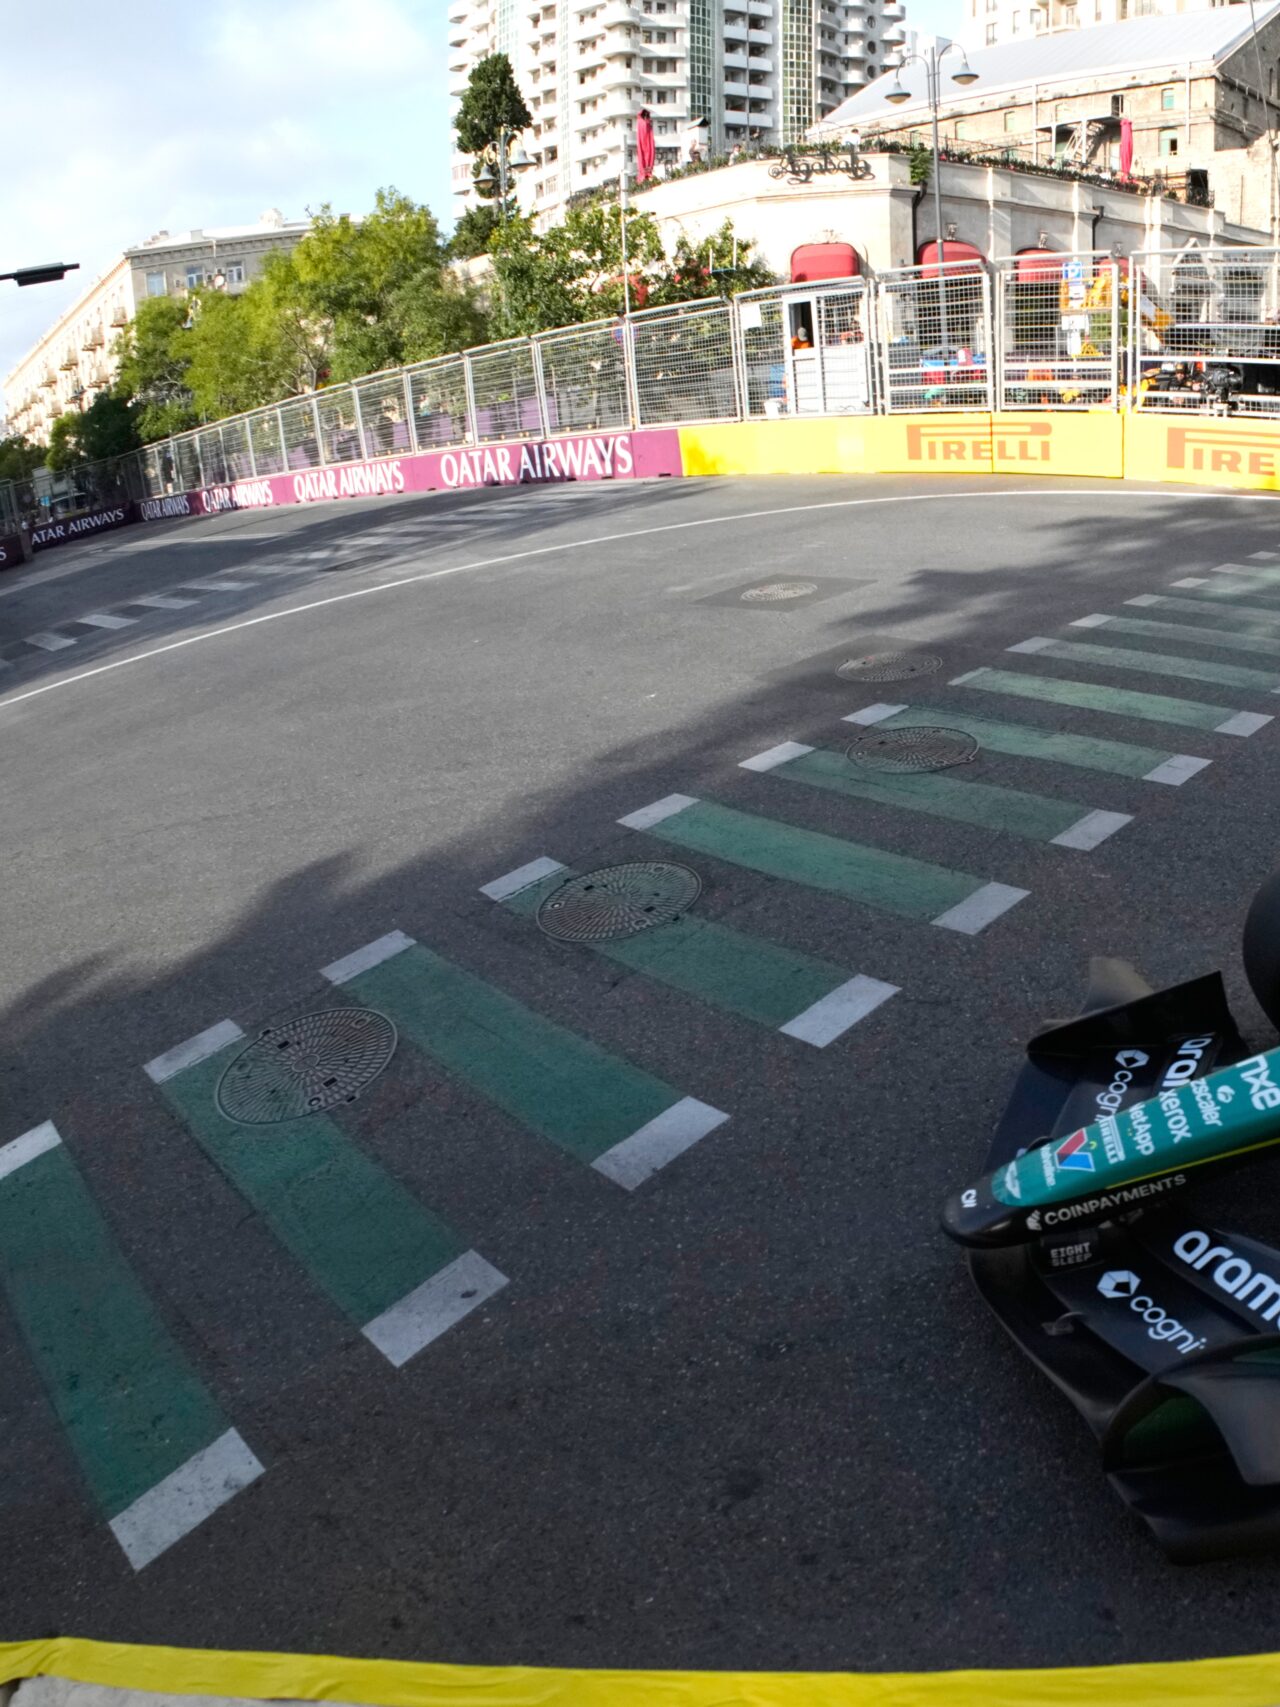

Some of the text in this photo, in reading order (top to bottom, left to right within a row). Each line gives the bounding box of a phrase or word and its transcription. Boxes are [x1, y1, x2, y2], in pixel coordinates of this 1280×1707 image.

[440, 435, 633, 487] QATAR AIRWAYS
[906, 421, 1053, 461] PIRELLI
[202, 480, 274, 512] QATAR AIRWAYS
[293, 460, 404, 504] QATAR AIRWAYS
[31, 508, 125, 545] ATAR AIRWAYS
[140, 495, 190, 521] QATAR AIRWAYS
[1159, 1088, 1193, 1144] xerox
[1189, 1078, 1223, 1127] zscaler
[1044, 1173, 1187, 1226] COINPAYMENTS
[1050, 1241, 1092, 1258] EIGHT
[1051, 1251, 1093, 1268] SLEEP
[1130, 1296, 1207, 1354] cogni
